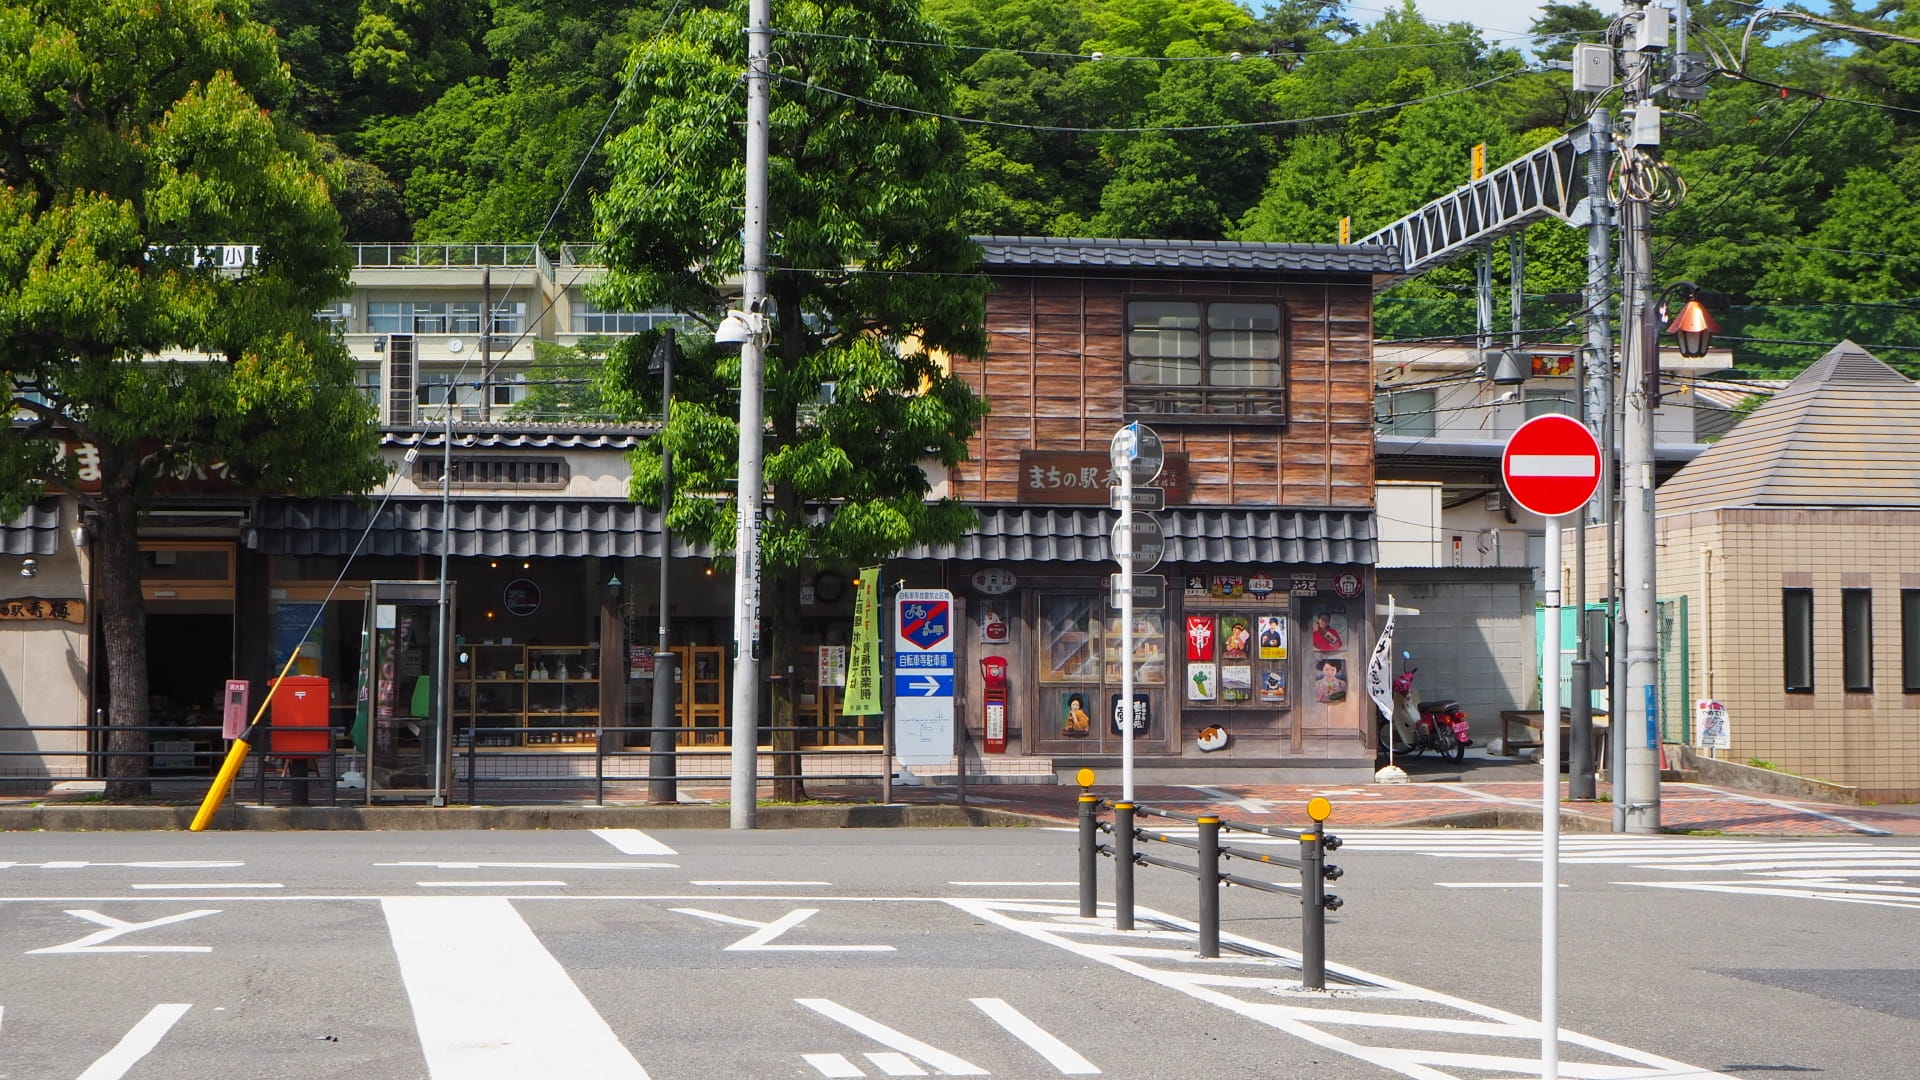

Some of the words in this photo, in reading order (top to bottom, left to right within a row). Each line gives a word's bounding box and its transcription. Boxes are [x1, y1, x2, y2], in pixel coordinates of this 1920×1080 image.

[1029, 465, 1122, 489] まちの駅青
